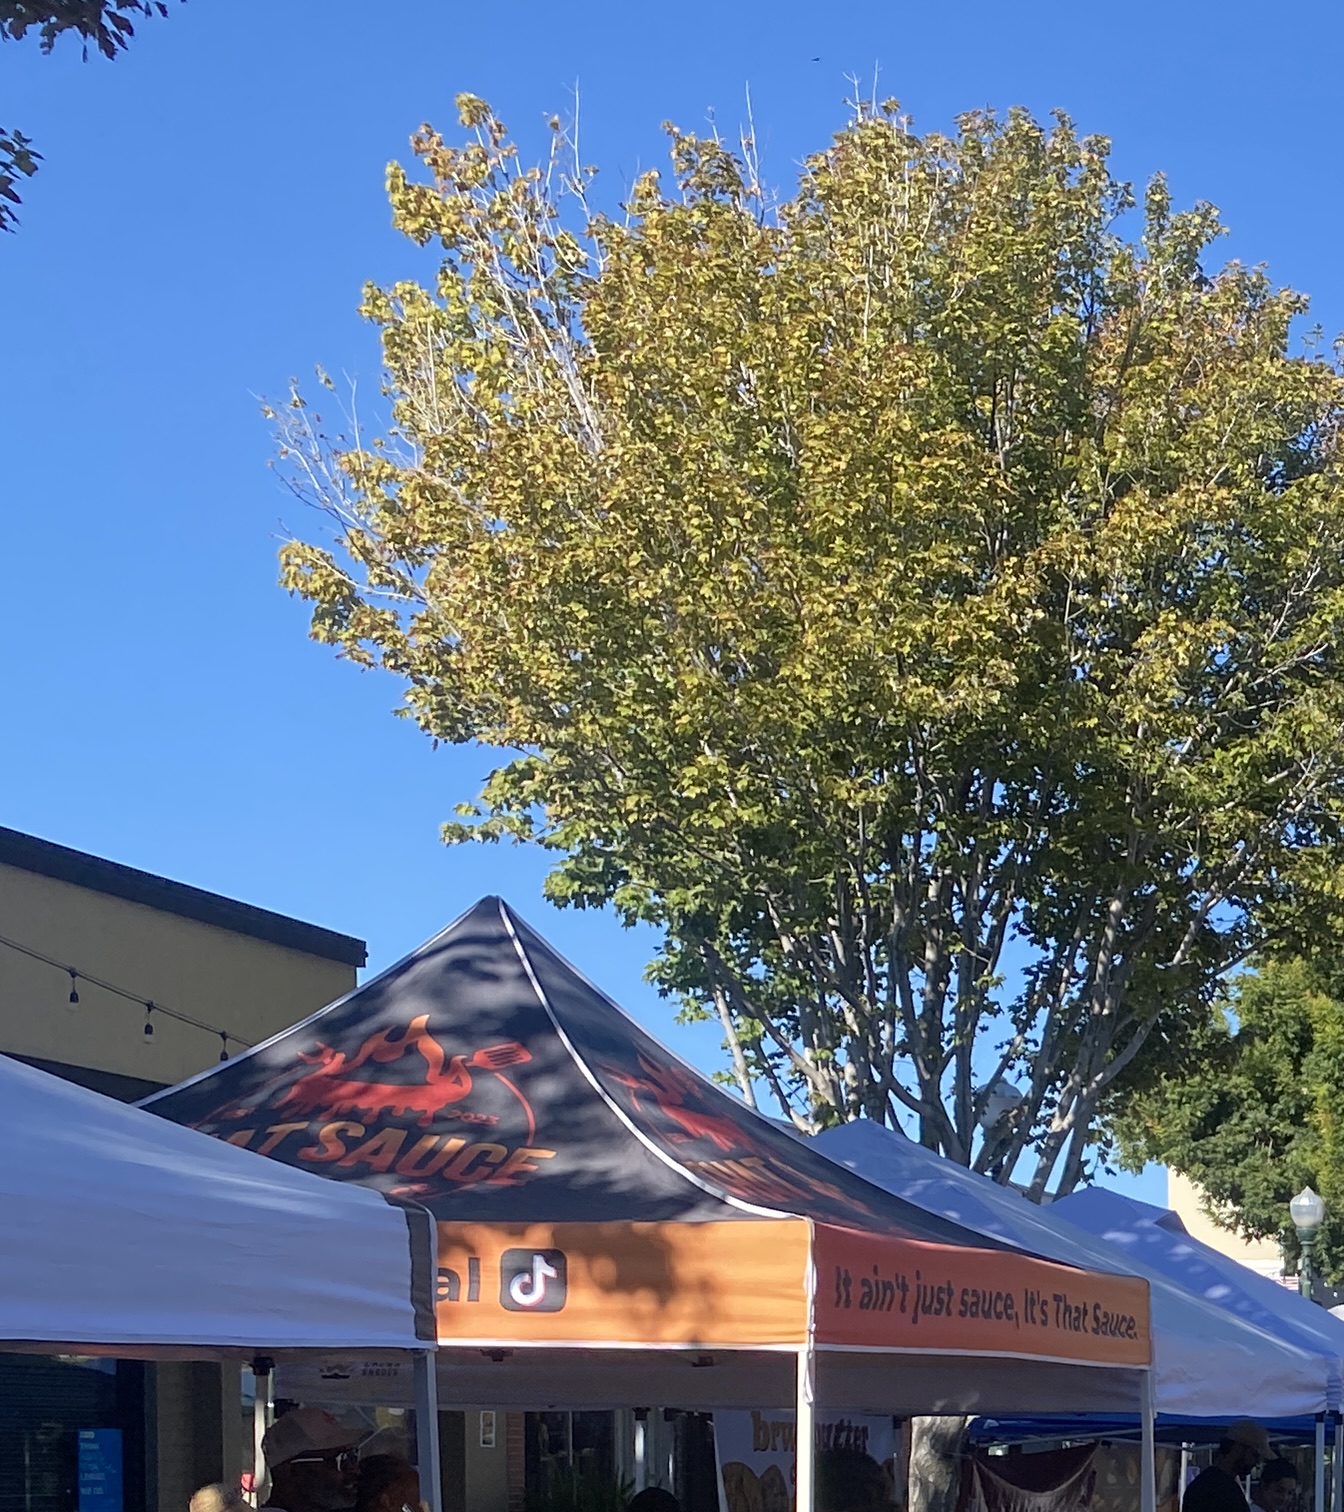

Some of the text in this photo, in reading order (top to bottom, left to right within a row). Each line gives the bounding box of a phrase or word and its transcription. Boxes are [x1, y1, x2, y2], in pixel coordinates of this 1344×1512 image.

[299, 1121, 557, 1186] SAUCE
[834, 1265, 1138, 1340] It ain't just sauce, It's That Sauce.
